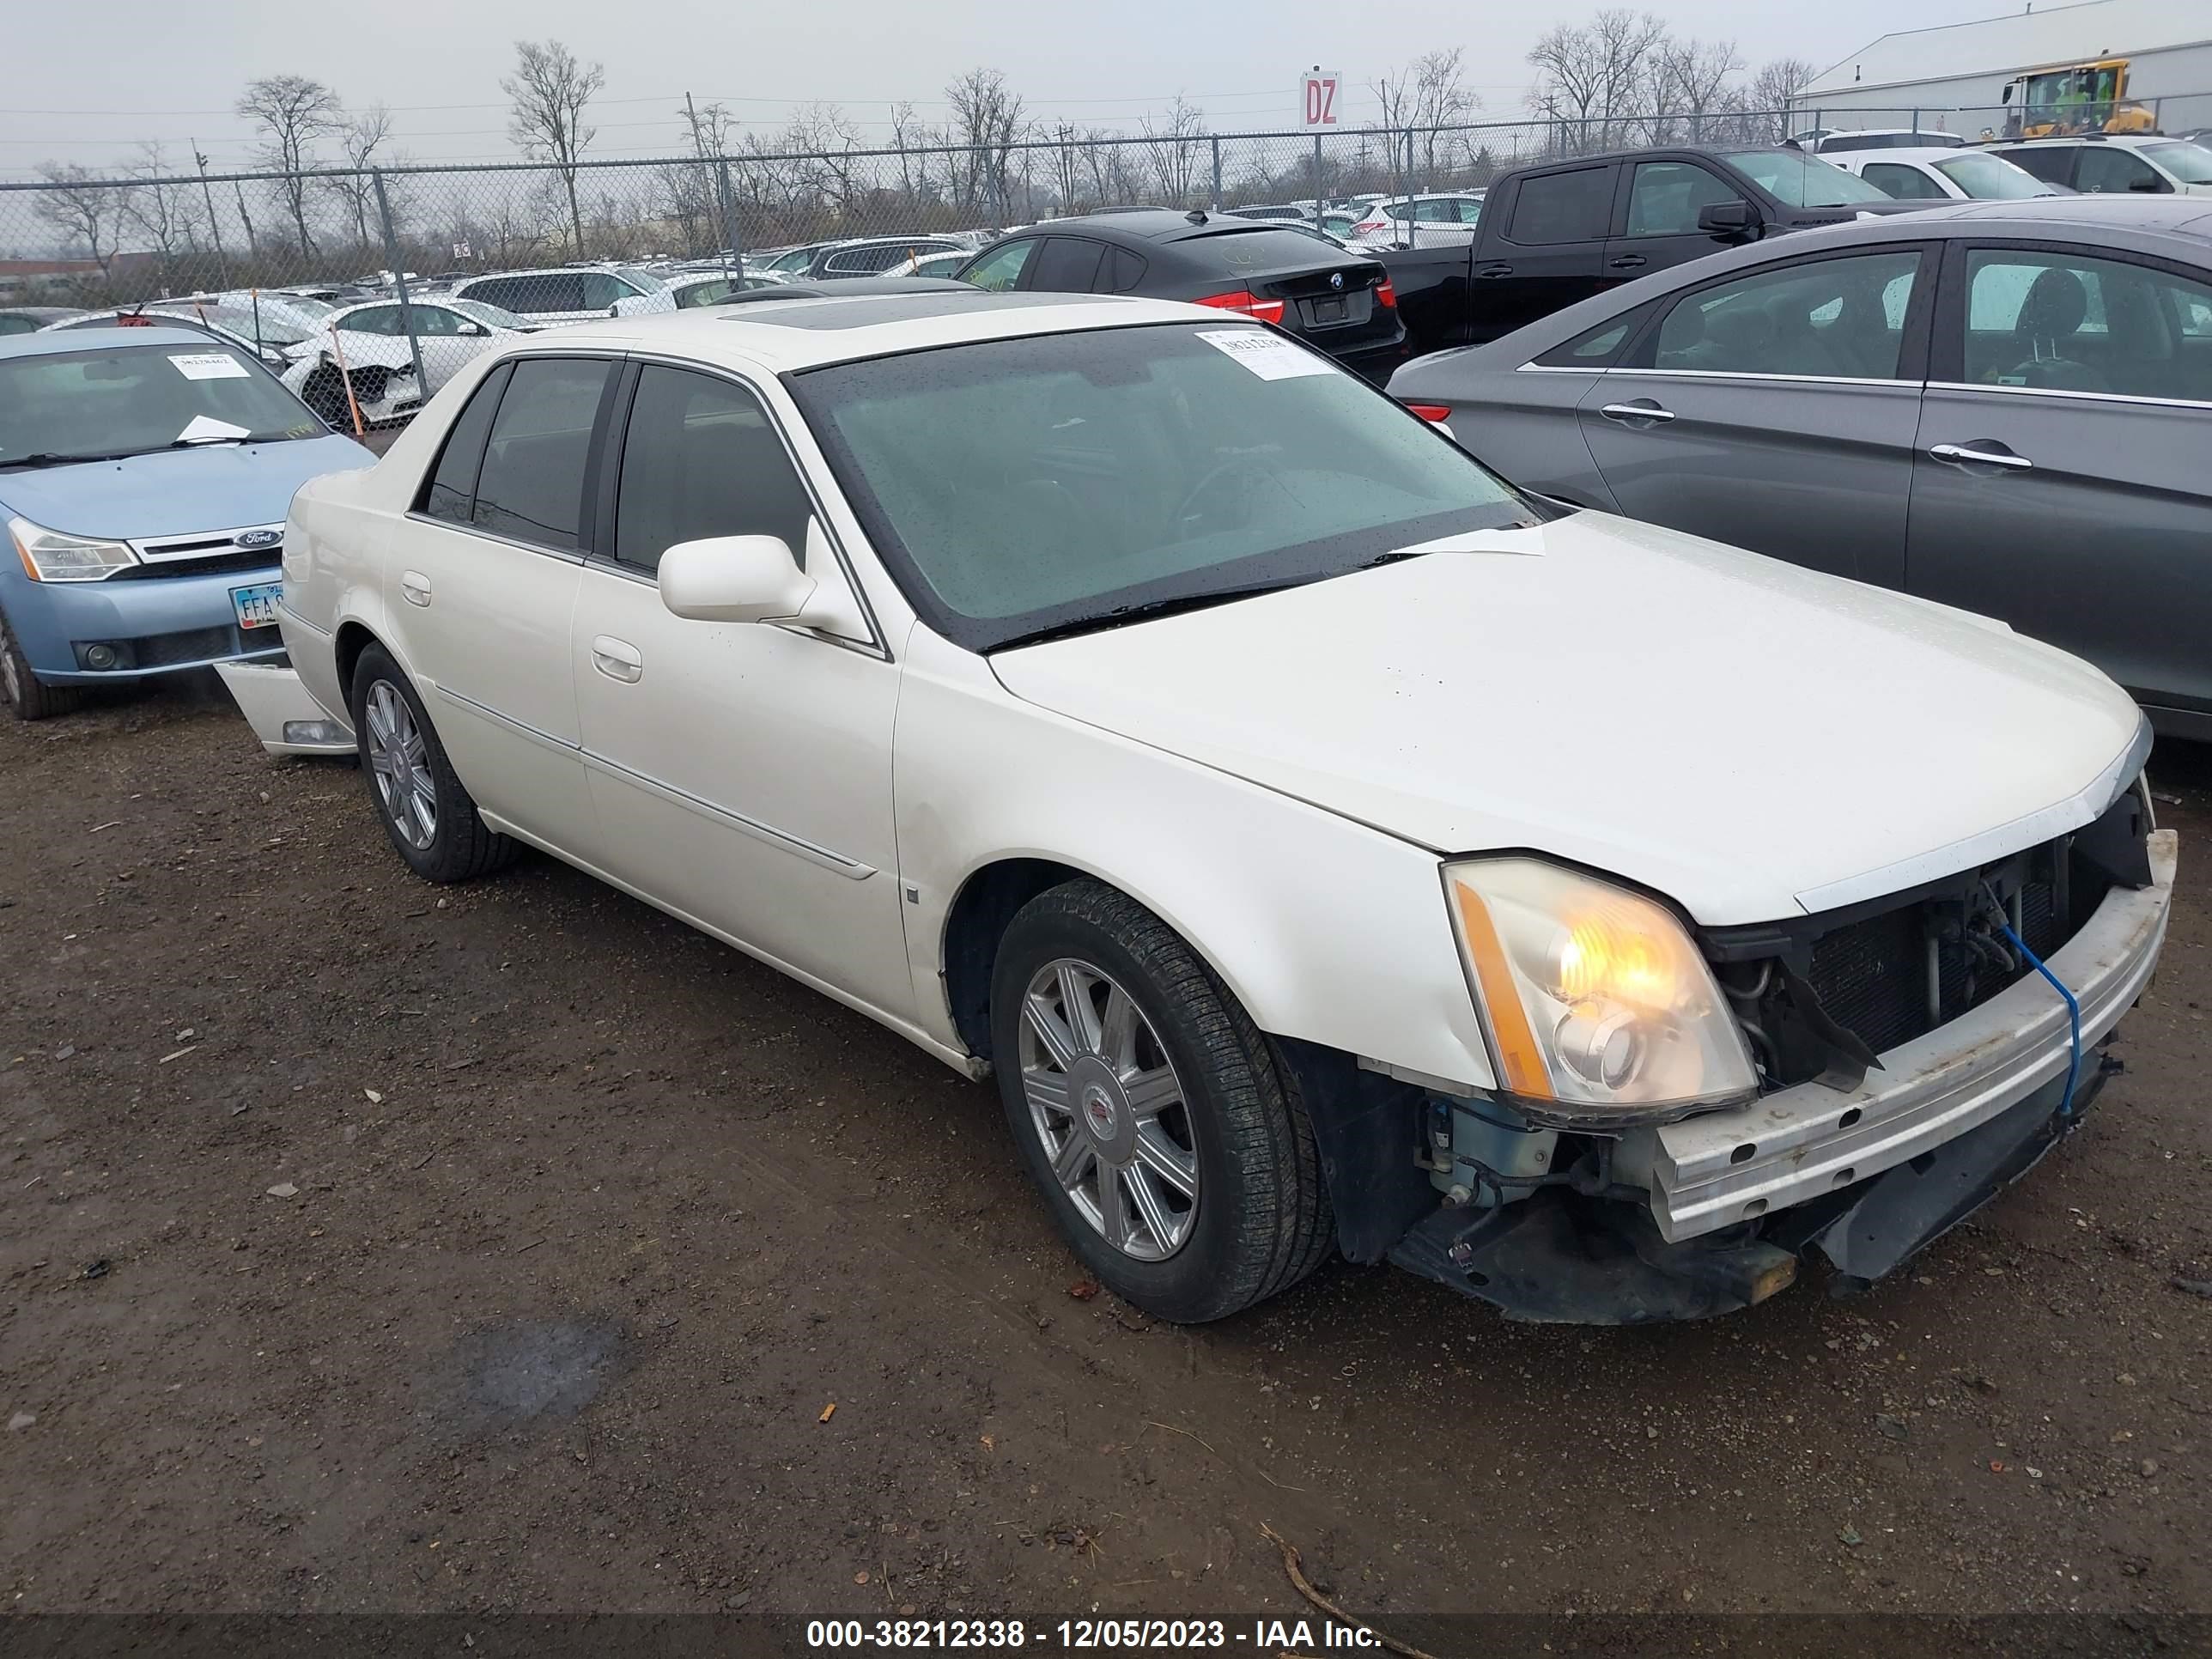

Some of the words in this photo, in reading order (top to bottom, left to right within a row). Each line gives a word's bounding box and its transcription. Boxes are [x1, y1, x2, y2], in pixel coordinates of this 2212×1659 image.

[1306, 79, 1337, 125] DZ
[246, 532, 272, 544] Ford
[241, 596, 273, 618] FFA
